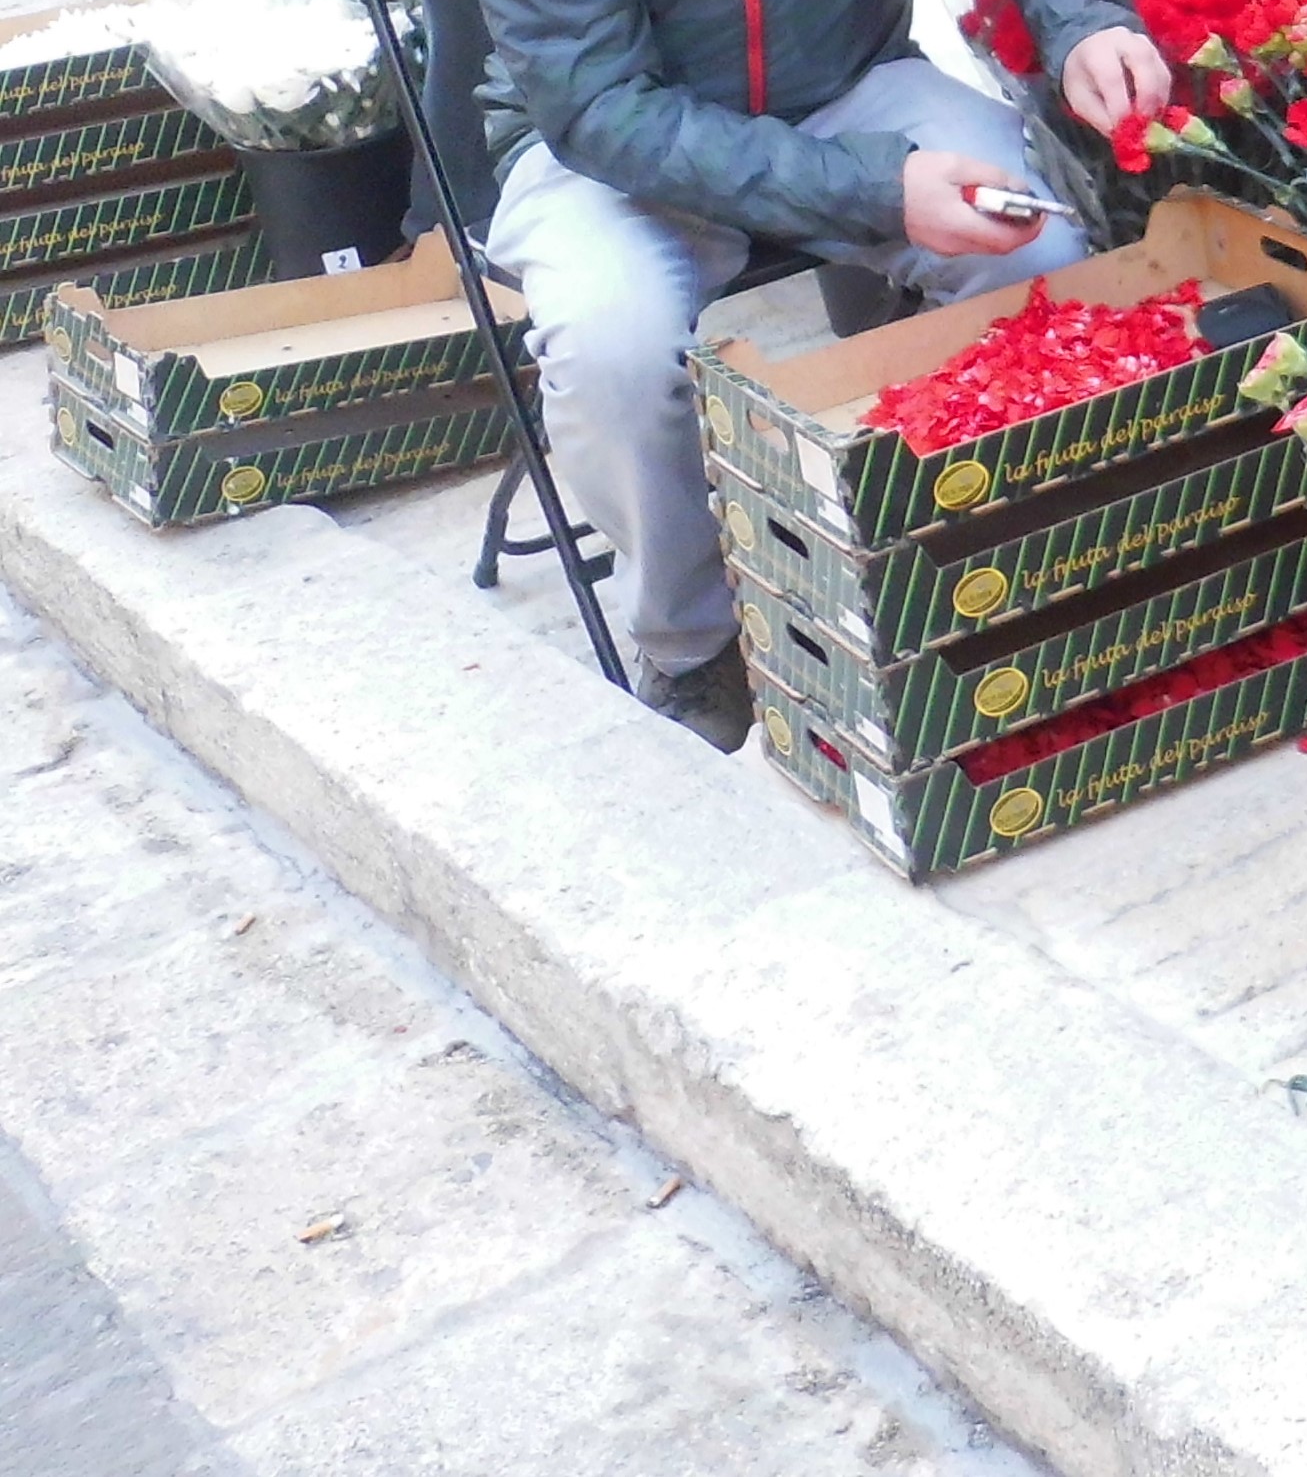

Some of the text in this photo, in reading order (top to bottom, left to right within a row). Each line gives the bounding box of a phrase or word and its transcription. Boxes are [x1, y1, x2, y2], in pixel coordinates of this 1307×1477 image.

[1004, 394, 1227, 484] la fruta del paraiso
[1022, 496, 1242, 590] la fruta del paraiso
[1042, 593, 1258, 689] la fruta del paraiso
[1056, 711, 1271, 808] la fruta del paraiso
